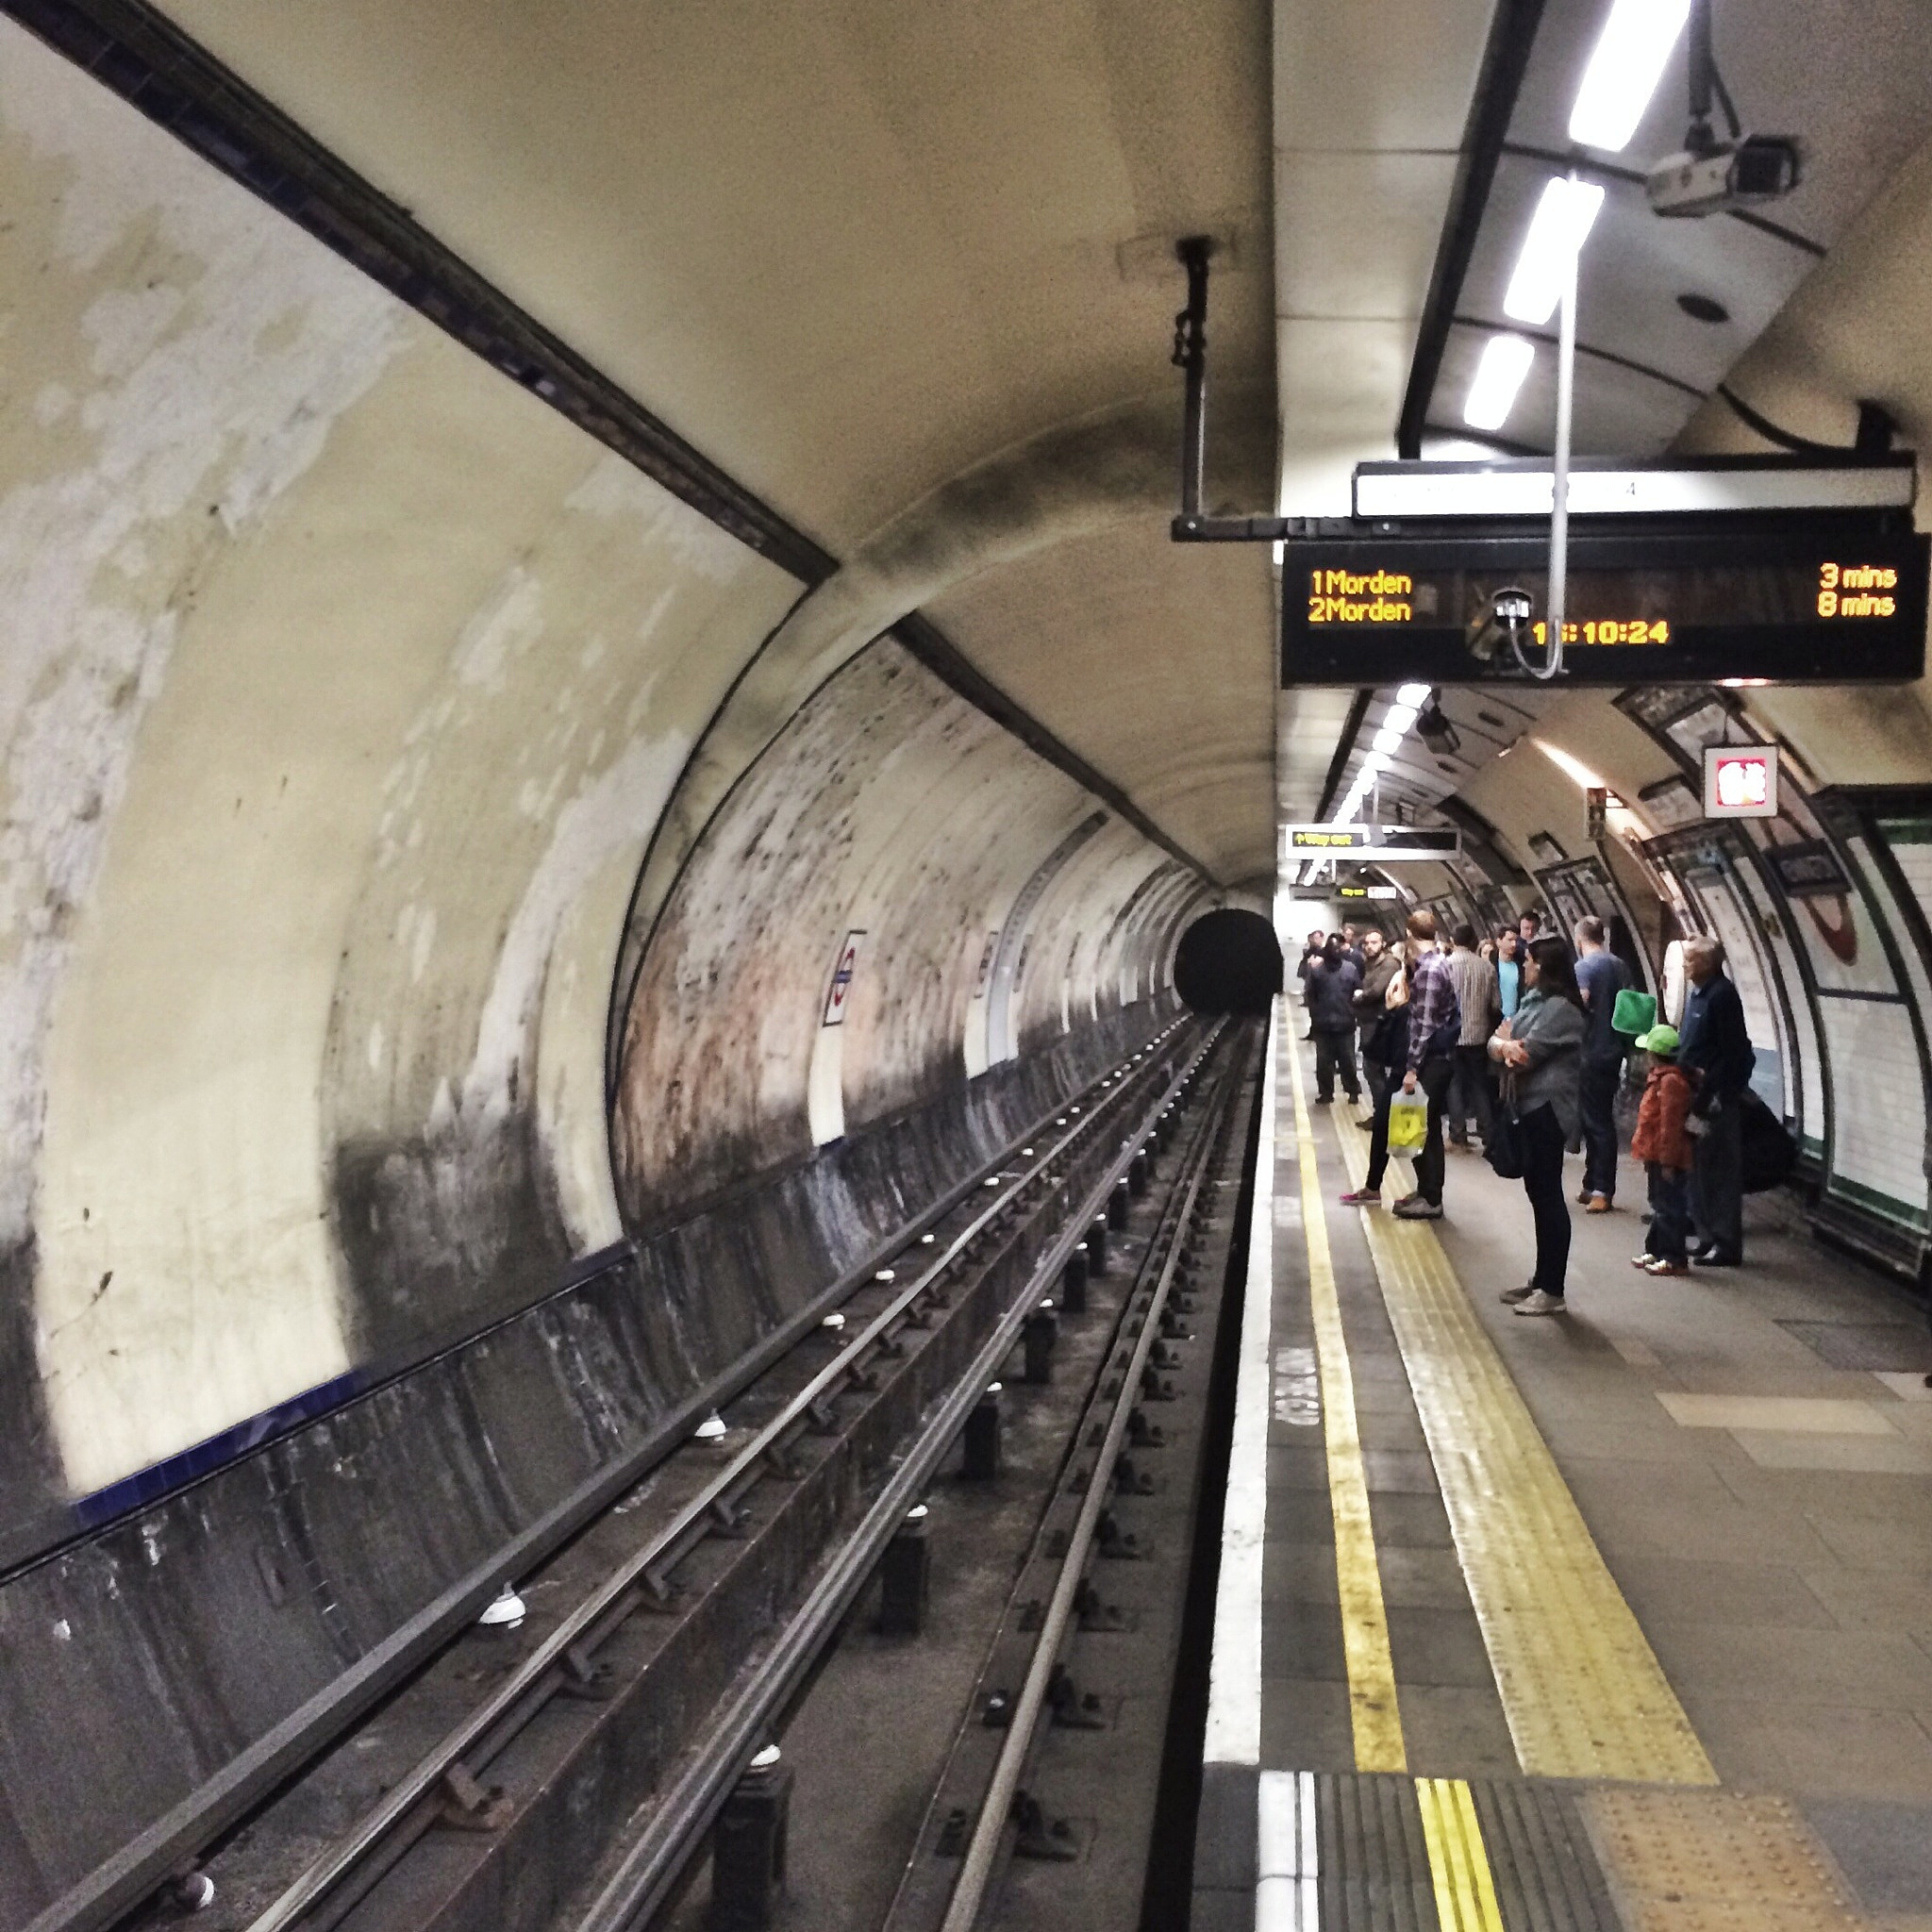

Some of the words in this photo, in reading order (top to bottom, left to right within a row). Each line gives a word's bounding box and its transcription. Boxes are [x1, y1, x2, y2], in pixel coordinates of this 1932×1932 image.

[1820, 562, 1840, 589] 3
[1842, 565, 1898, 589] mins
[1840, 592, 1896, 617] mins
